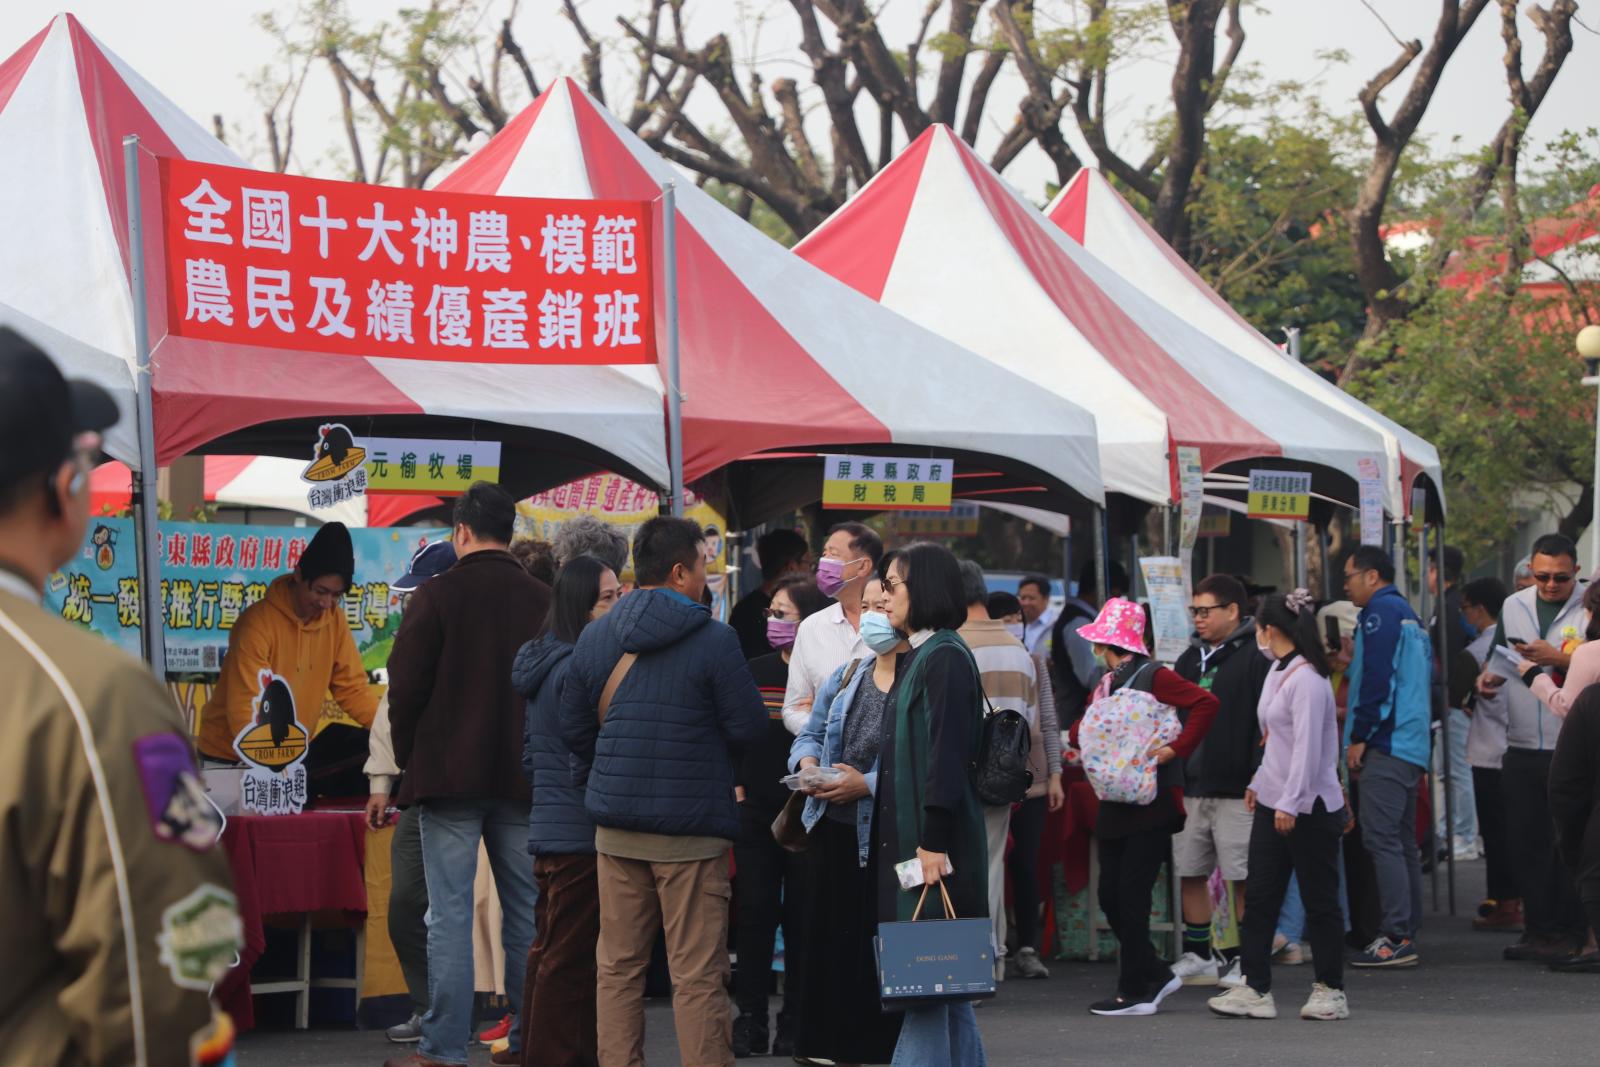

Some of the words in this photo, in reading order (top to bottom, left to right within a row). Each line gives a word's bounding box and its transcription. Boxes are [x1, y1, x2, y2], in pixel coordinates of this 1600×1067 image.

[181, 179, 637, 275] 全國十大神農、模範
[185, 259, 642, 350] 農民及績優產銷班
[371, 447, 473, 480] 元榆牧場
[837, 461, 942, 481] 屏東縣政府
[853, 484, 925, 503] 財稅局
[157, 531, 306, 572] 東縣政府財稅
[254, 749, 275, 761] FROM
[277, 747, 296, 760] FARM
[244, 768, 305, 811] 台灣衝浪雞
